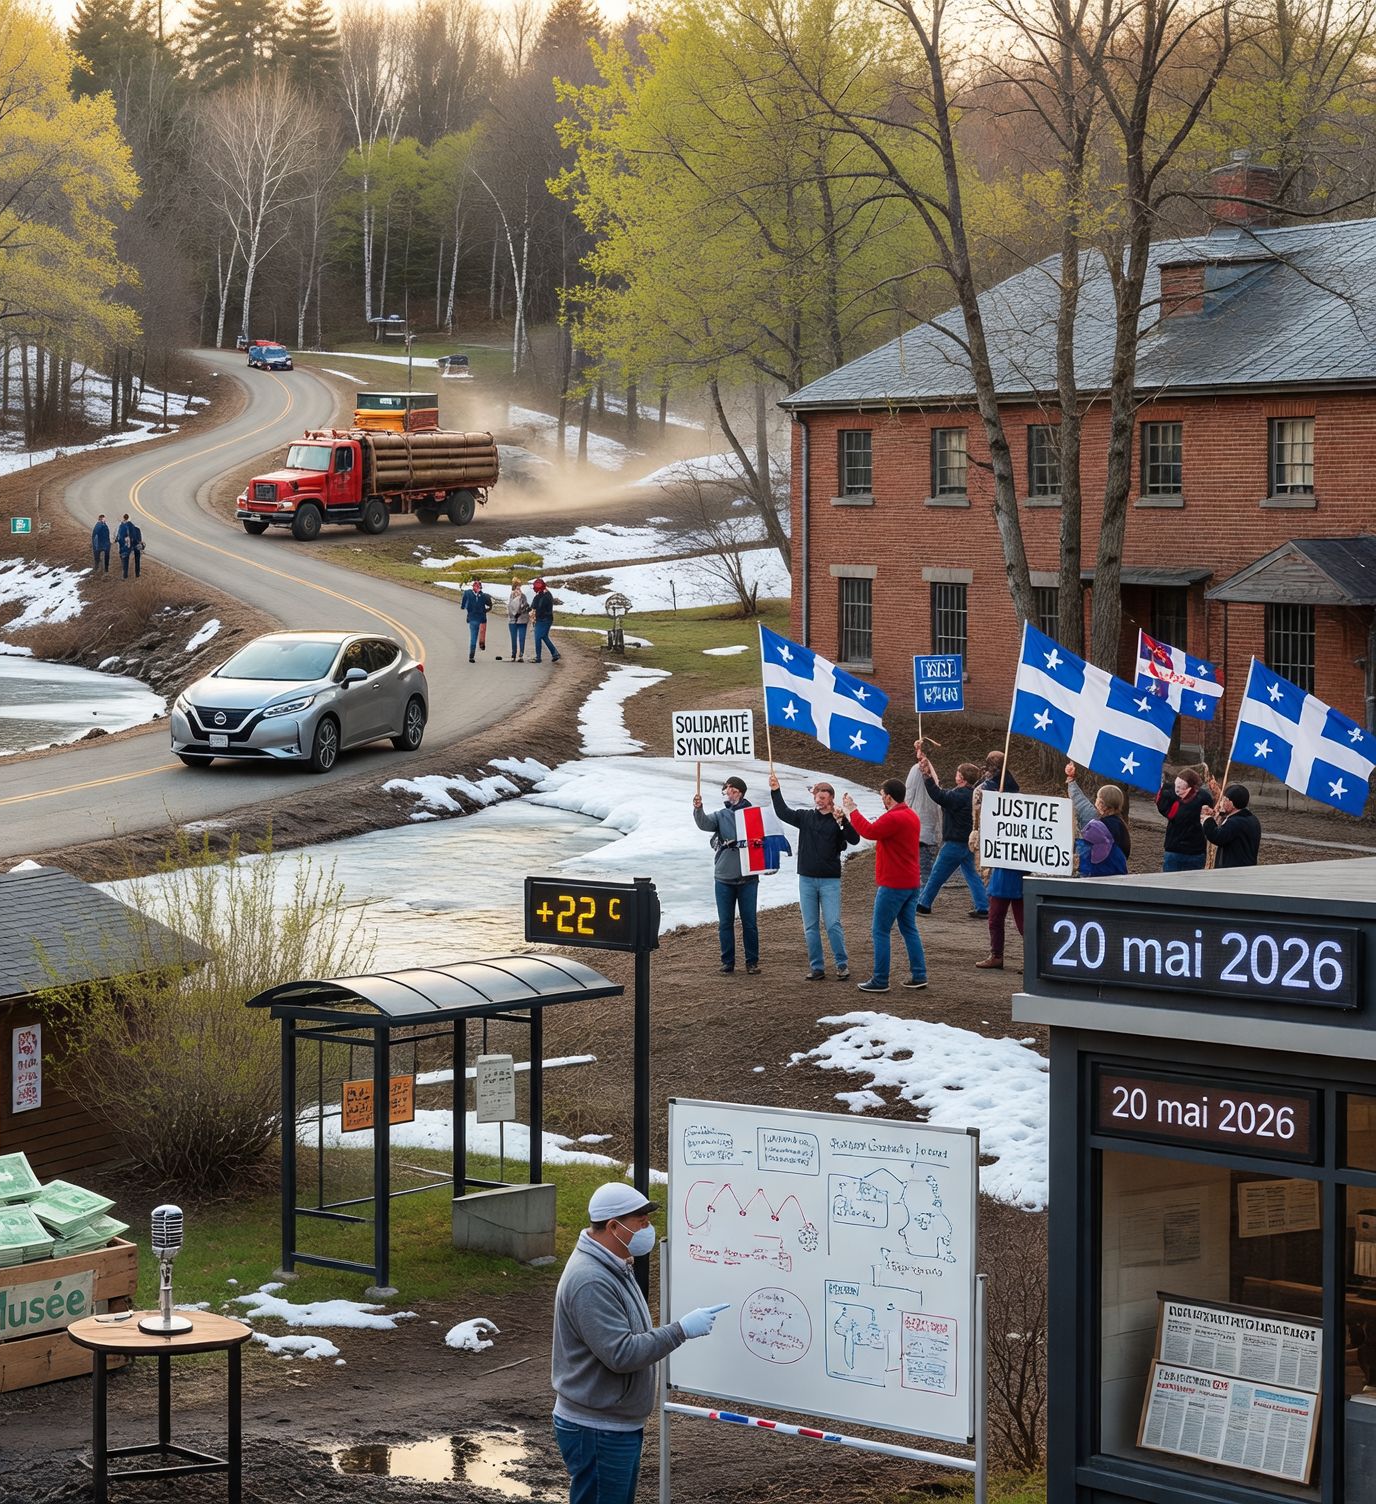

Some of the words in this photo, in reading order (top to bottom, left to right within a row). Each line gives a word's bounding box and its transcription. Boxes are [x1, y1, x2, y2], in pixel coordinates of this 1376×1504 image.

[675, 712, 749, 734] SOLIDARITÉ
[676, 736, 751, 756] SYNDICALE
[992, 797, 1060, 823] JUSTICE
[997, 821, 1028, 839] POUR
[1031, 824, 1053, 841] LES
[536, 895, 596, 935] +22
[1052, 919, 1106, 969] 20
[1123, 929, 1202, 978] mai
[1219, 932, 1343, 991] 2026
[1112, 1086, 1147, 1120] 20
[1157, 1096, 1208, 1129] mai
[1218, 1099, 1295, 1139] 2026
